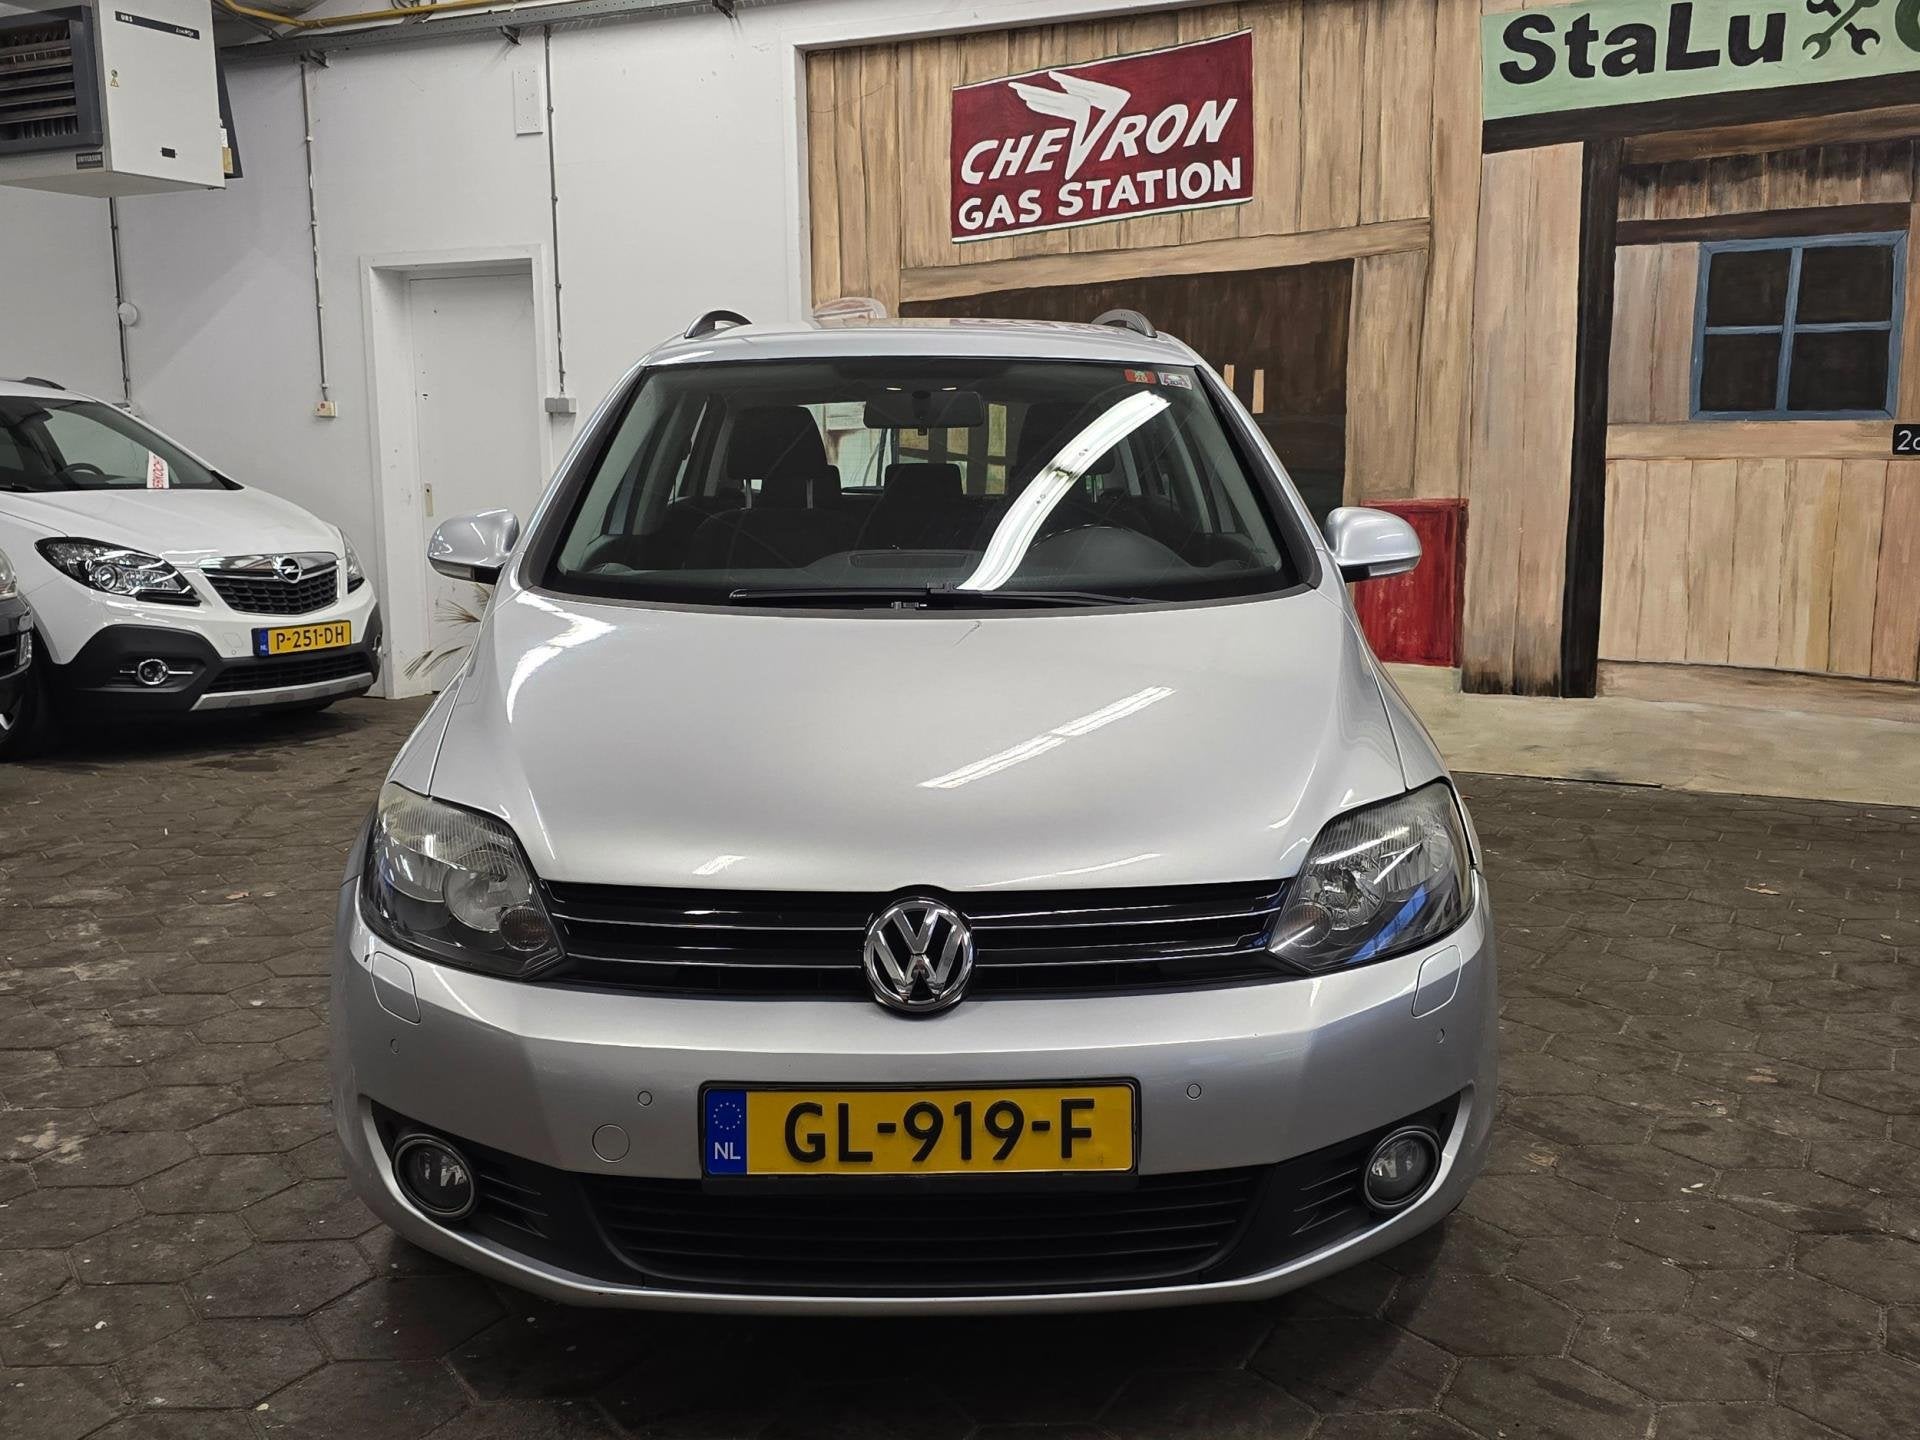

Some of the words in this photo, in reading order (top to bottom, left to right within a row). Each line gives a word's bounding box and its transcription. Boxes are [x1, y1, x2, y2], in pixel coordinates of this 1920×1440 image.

[1500, 1, 1787, 85] StaLu
[961, 72, 1238, 184] CHEVRON
[958, 189, 1043, 230] GAS
[1058, 157, 1242, 216] STATION
[276, 626, 345, 650] P-251-DH
[713, 1142, 741, 1160] NL
[784, 1097, 1095, 1163] GL-919-F
